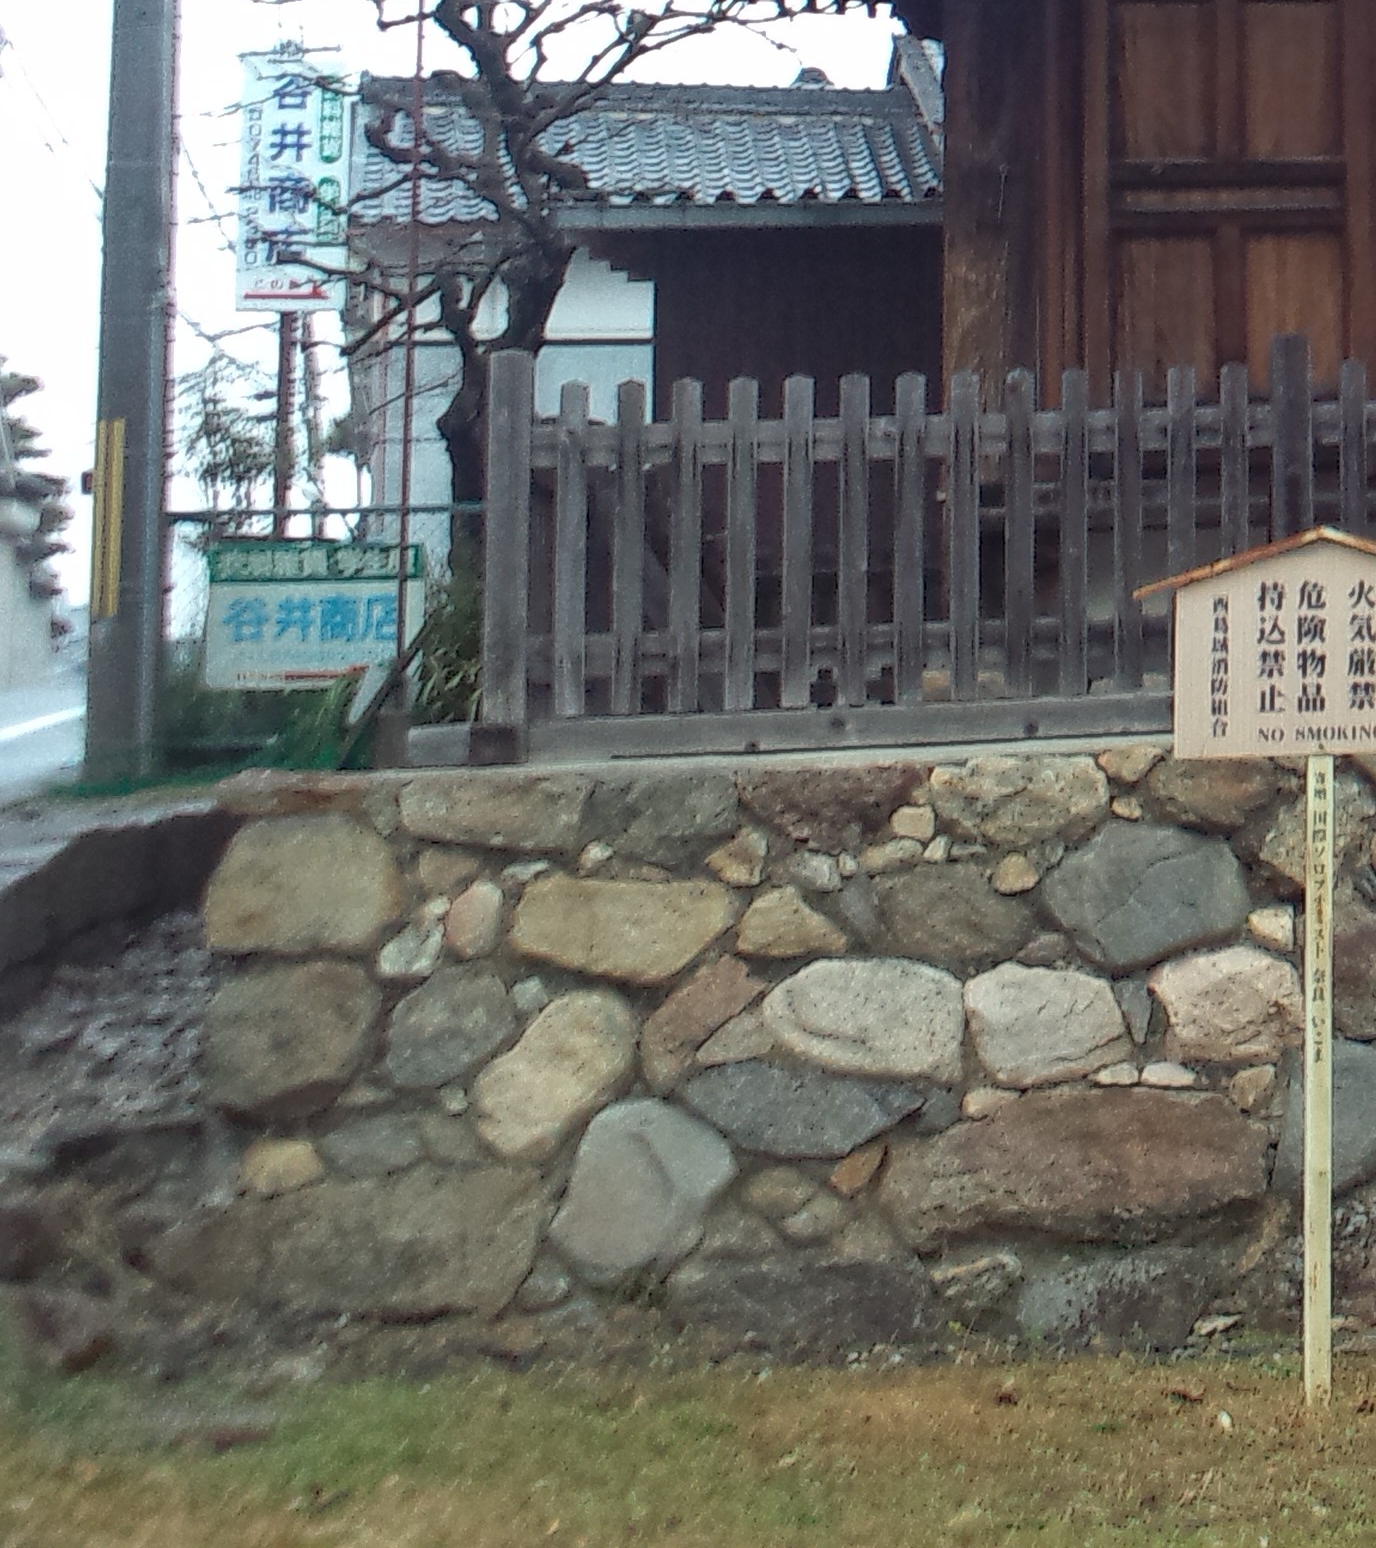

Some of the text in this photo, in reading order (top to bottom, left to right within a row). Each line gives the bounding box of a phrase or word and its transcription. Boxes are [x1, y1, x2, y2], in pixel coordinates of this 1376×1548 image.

[223, 593, 398, 643] 谷井商店
[1257, 581, 1286, 714] 持込禁止
[1297, 579, 1327, 712] 危険物品
[1348, 579, 1376, 710] 火気厳禁
[1258, 727, 1284, 743] NO
